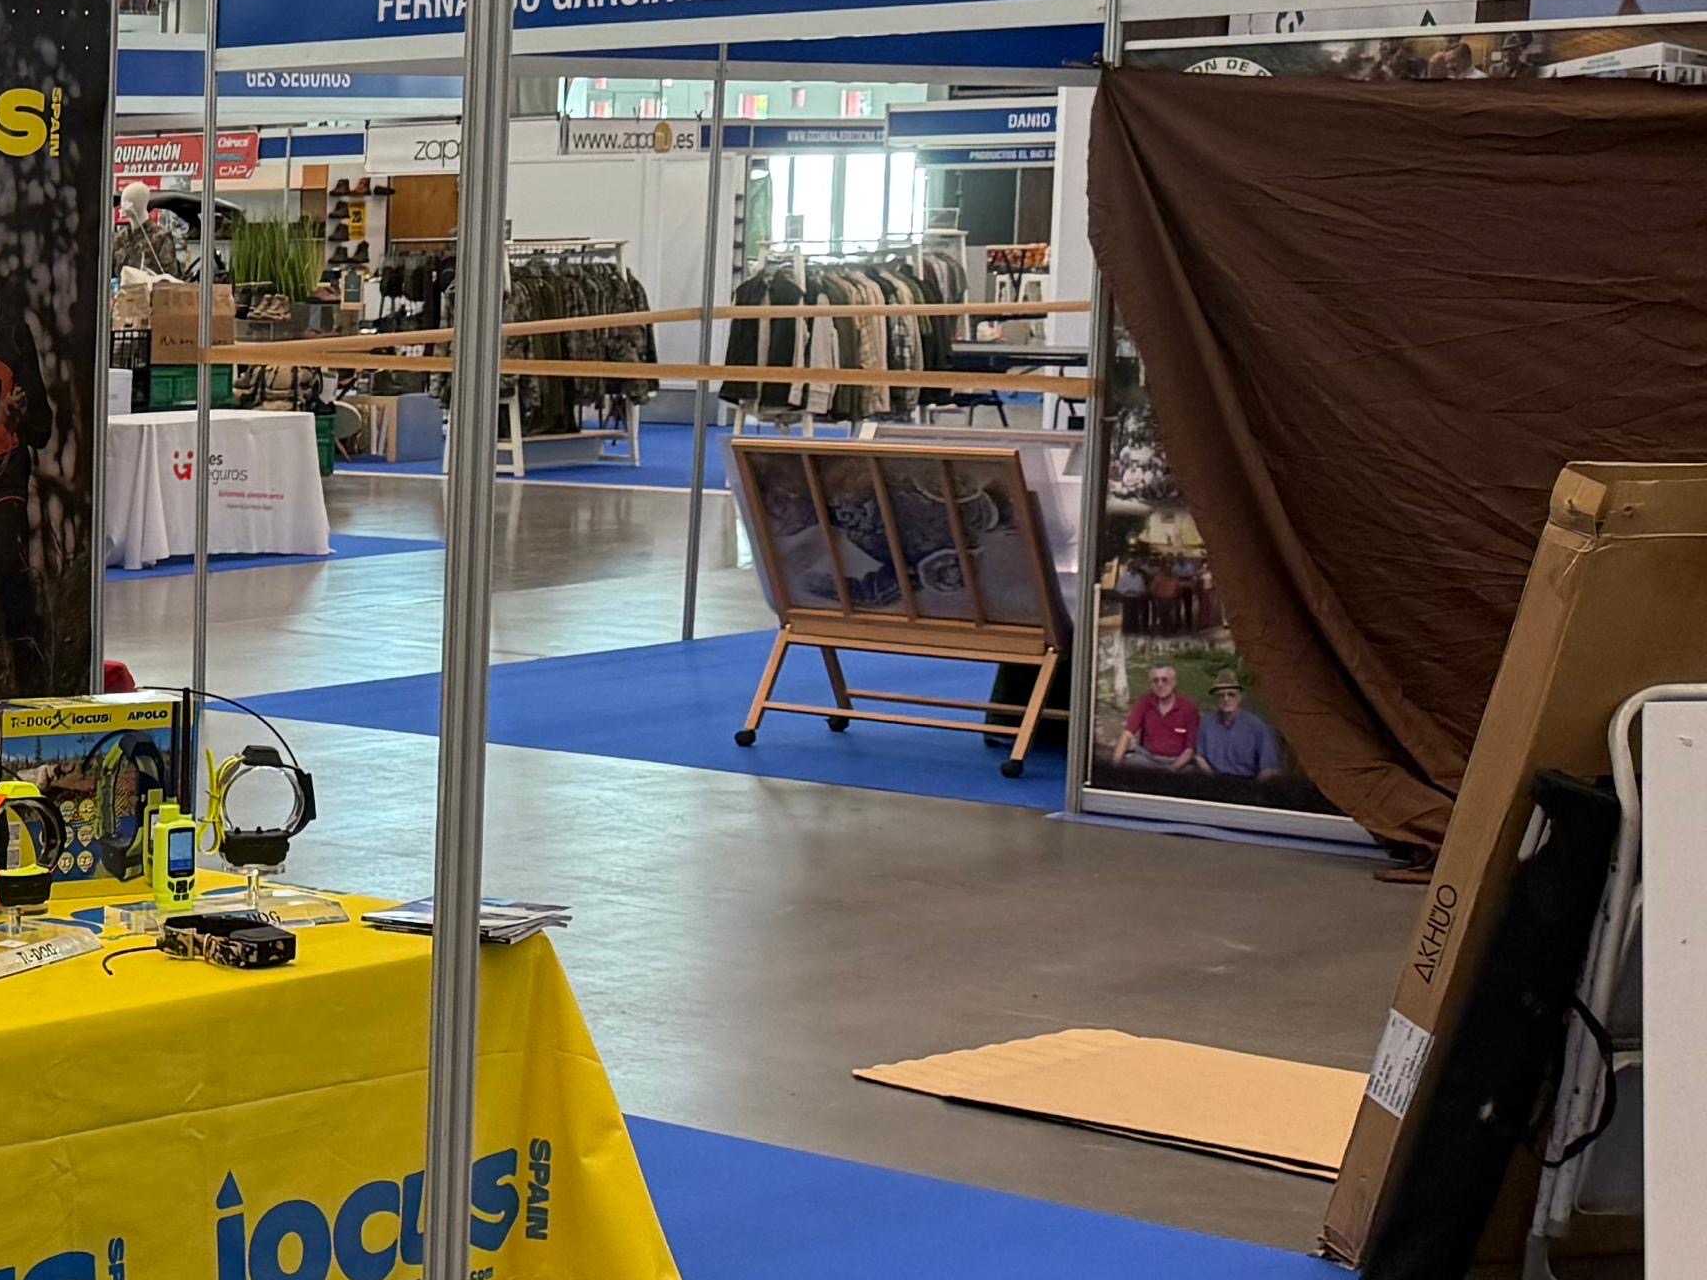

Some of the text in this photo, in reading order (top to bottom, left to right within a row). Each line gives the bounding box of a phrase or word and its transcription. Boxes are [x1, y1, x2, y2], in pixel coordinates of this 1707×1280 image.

[49, 86, 63, 158] SPAIN
[114, 141, 182, 164] QUIDACIÓN
[127, 709, 169, 721] APOLO
[525, 1137, 552, 1241] SPAIN
